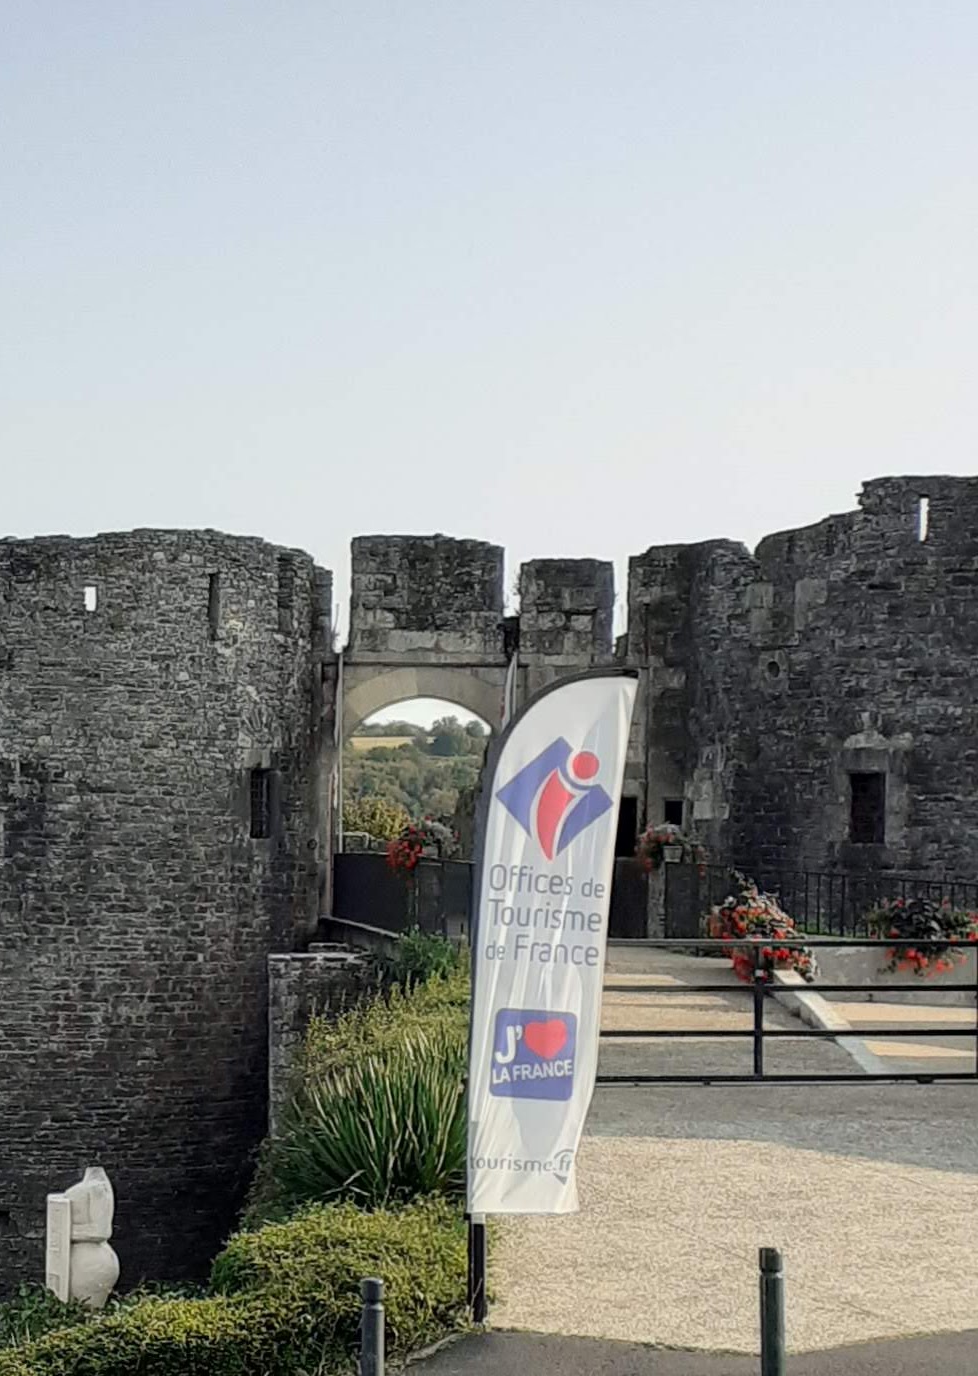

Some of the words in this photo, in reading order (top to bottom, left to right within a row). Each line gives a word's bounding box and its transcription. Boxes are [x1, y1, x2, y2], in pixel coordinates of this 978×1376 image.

[489, 864, 574, 895] Offices
[581, 877, 605, 899] de
[488, 898, 603, 932] Tourisme
[485, 941, 507, 961] de
[513, 934, 600, 966] France
[492, 1067, 511, 1085] LA
[512, 1059, 573, 1081] FRANCE
